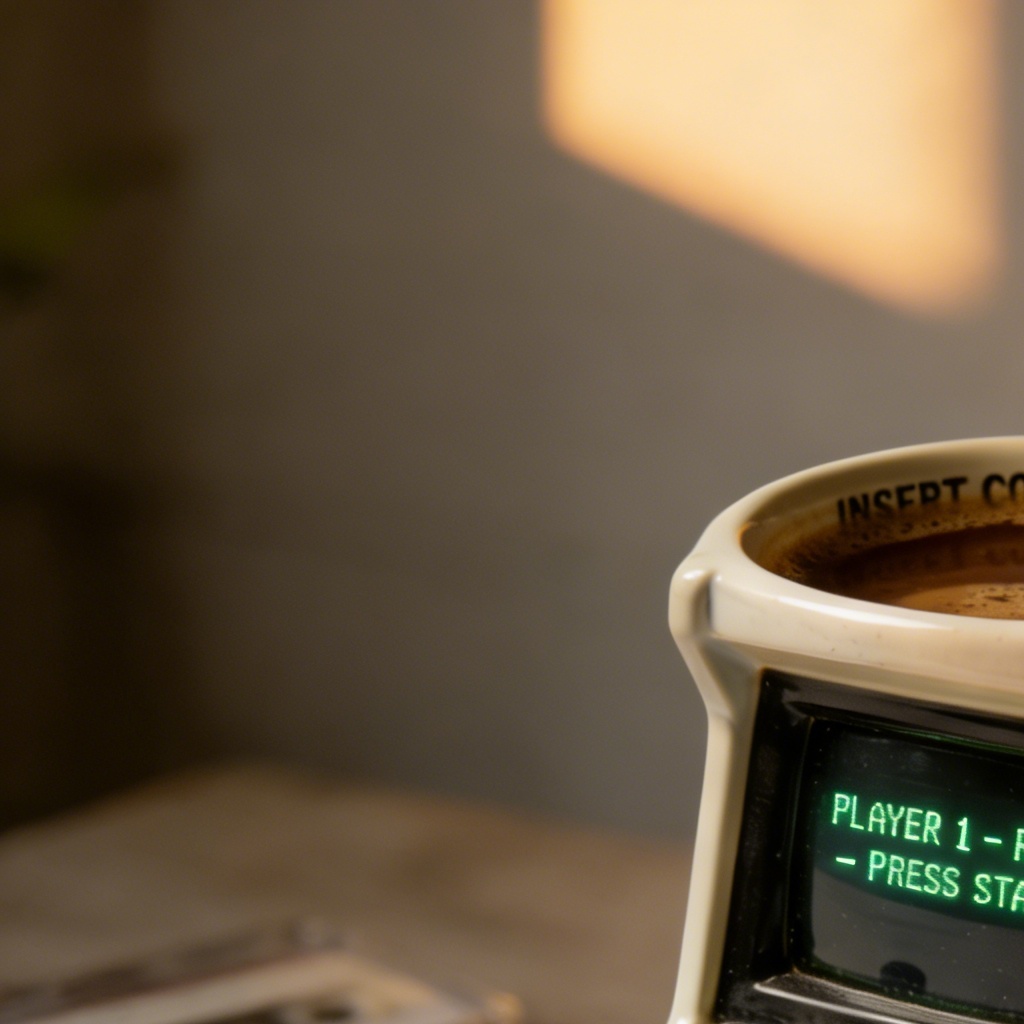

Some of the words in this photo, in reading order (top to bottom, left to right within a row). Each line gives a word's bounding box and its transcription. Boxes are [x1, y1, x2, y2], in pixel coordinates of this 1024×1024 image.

[837, 477, 968, 524] INSERT
[832, 793, 942, 846] PLAYER
[956, 817, 970, 852] 1
[868, 850, 961, 898] PRESS
